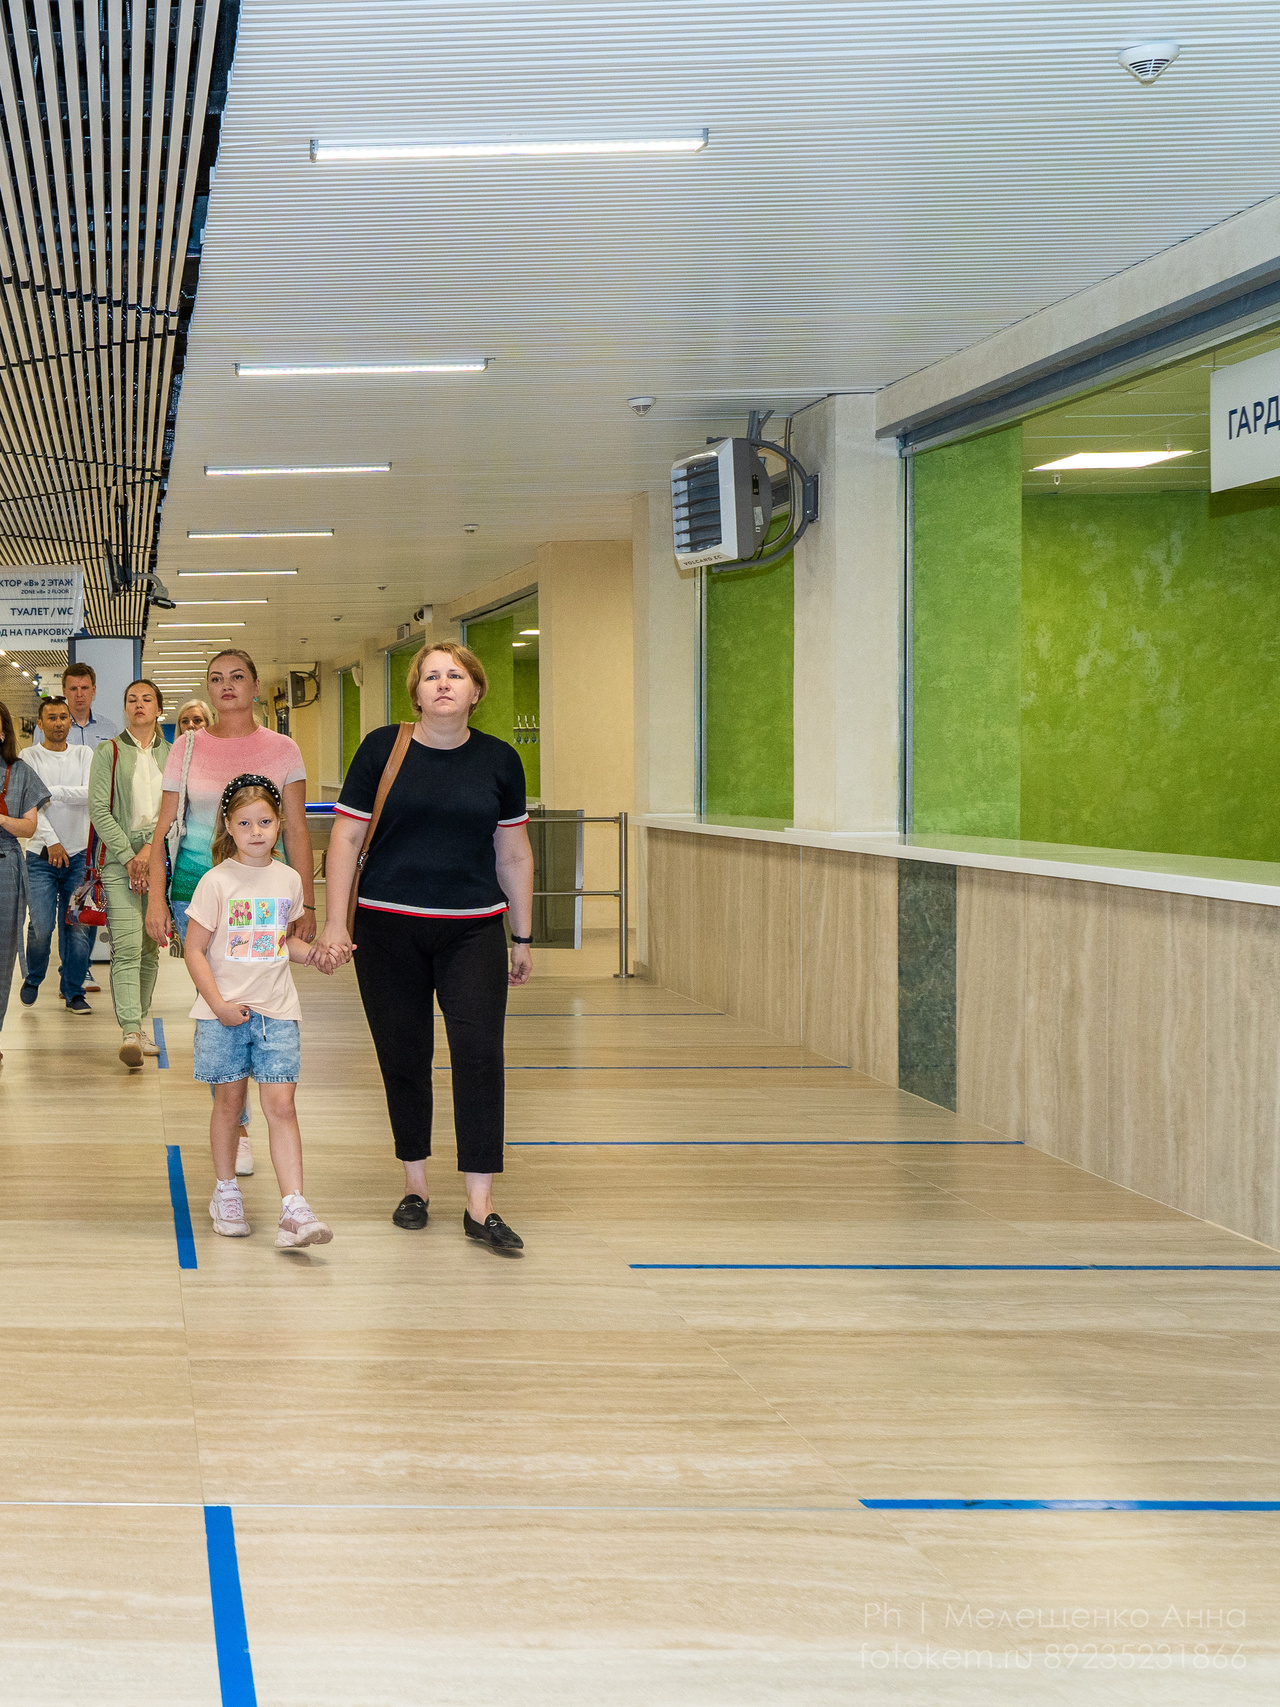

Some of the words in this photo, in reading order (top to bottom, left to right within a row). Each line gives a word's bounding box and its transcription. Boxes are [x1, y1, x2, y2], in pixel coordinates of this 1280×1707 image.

[684, 557, 712, 566] VOLCANO
[41, 579, 46, 587] 2
[47, 578, 74, 587] ЭТАЖ
[10, 607, 50, 616] ТУАЛЕТ
[57, 607, 74, 616] WC
[9, 628, 22, 636] НА
[24, 628, 74, 637] ПАРКОВКУ
